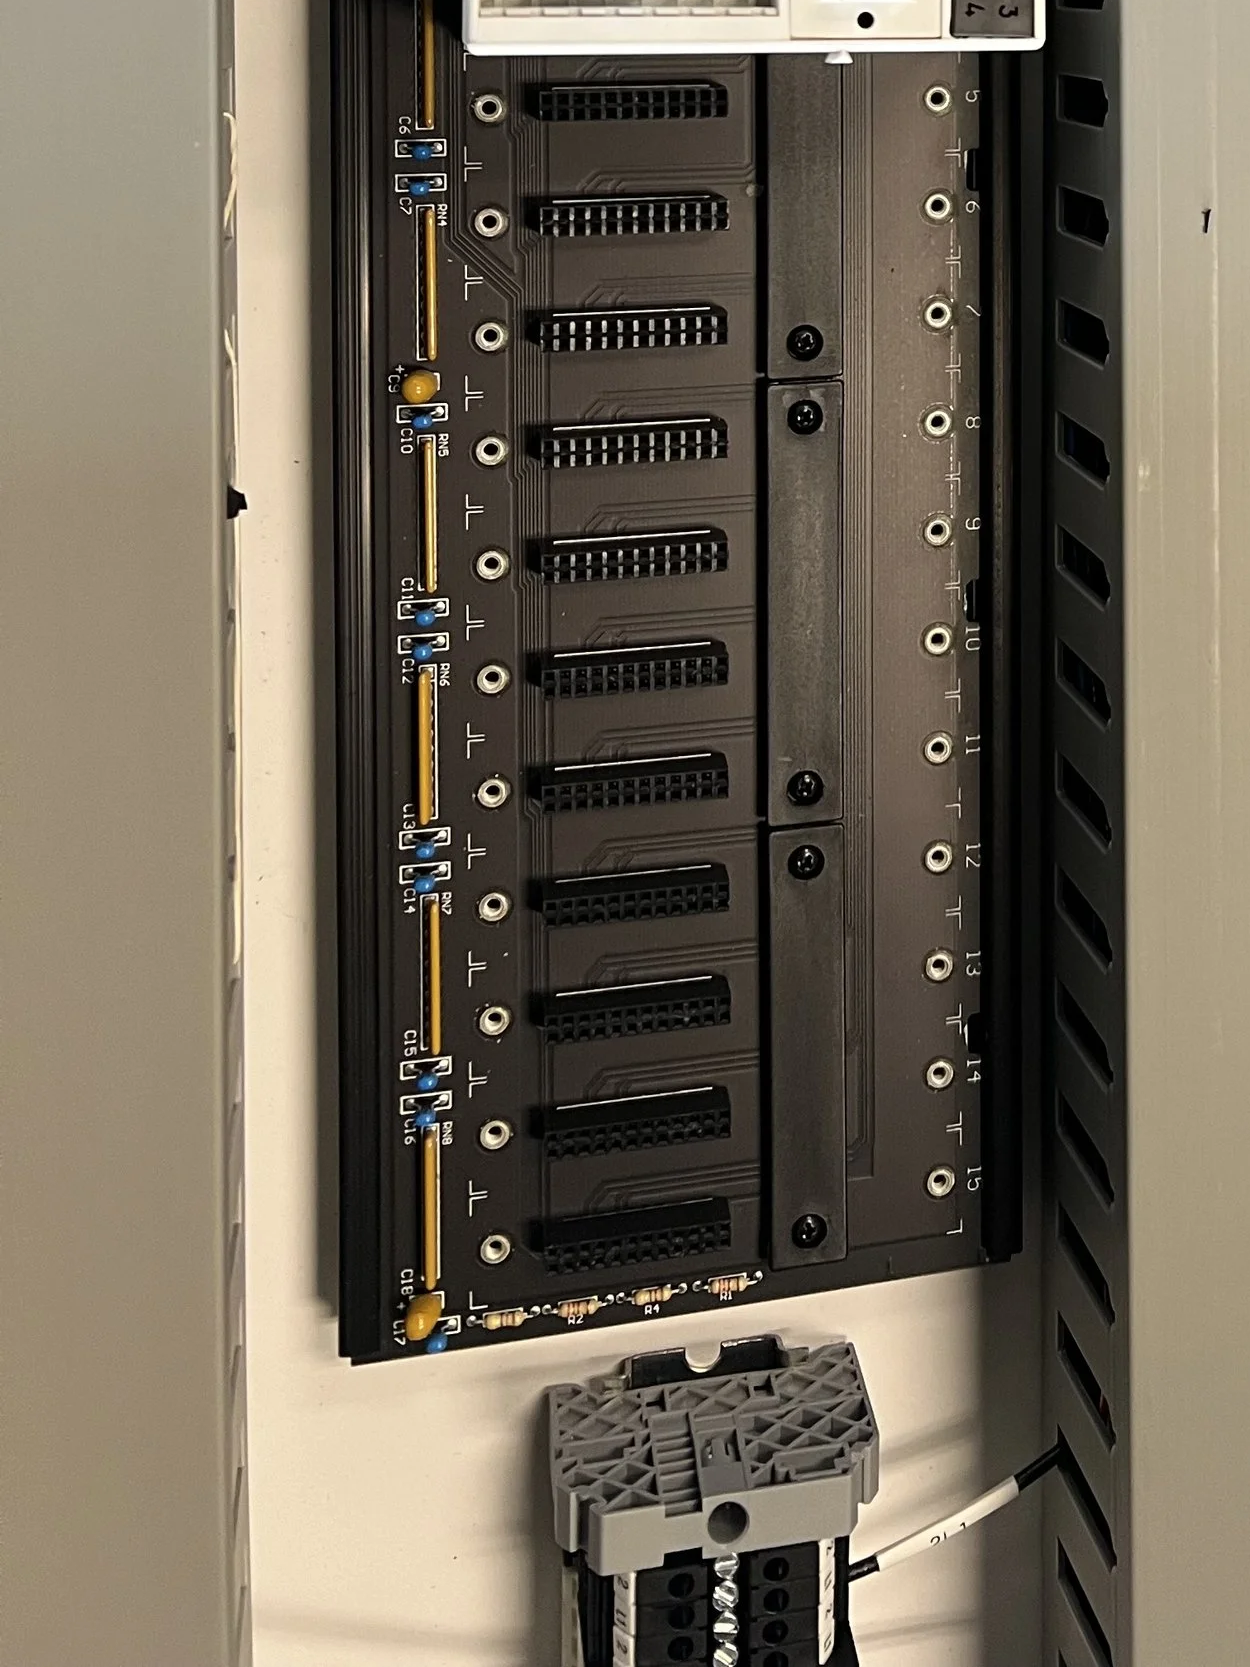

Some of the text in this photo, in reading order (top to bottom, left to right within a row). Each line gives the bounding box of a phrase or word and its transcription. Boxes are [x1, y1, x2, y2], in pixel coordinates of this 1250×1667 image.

[965, 3, 985, 17] 4
[999, 5, 1019, 18] 3
[398, 116, 411, 135] C6
[399, 197, 412, 215] C7
[437, 203, 448, 227] RN4
[388, 375, 400, 393] C9
[966, 416, 980, 429] 8
[401, 429, 413, 454] C10
[438, 433, 449, 457] RN5
[966, 517, 980, 531] 9
[401, 577, 414, 600] C11
[965, 625, 980, 652] 10
[402, 658, 414, 684] C12
[439, 663, 450, 687] RN6
[403, 888, 416, 914] C14
[441, 892, 452, 915] RN7
[404, 1030, 417, 1057] C15
[966, 1058, 981, 1083] 14
[442, 1121, 453, 1145] RN8
[401, 1269, 413, 1295] C18
[568, 1315, 584, 1325] R2
[645, 1304, 659, 1315] R4
